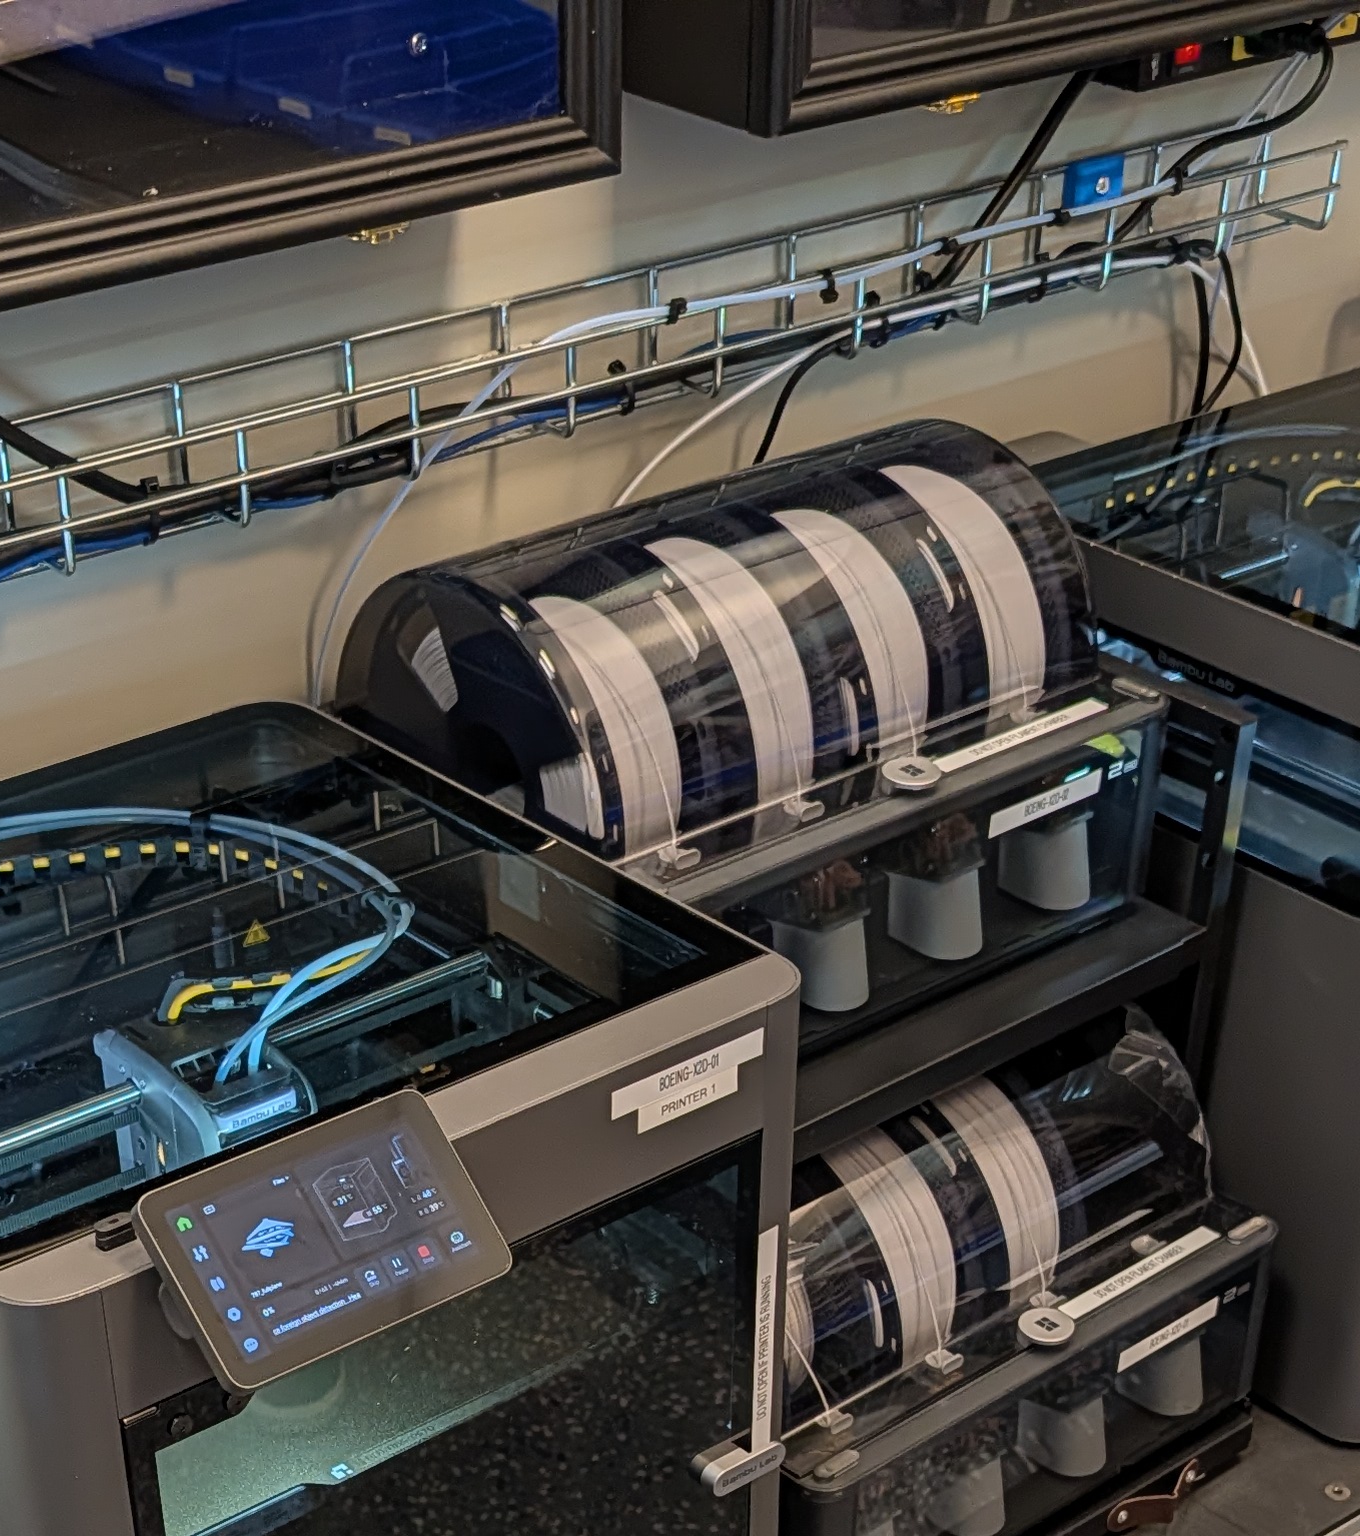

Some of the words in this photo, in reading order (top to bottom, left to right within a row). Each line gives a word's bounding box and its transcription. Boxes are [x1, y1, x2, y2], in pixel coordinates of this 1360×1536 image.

[659, 1053, 719, 1092] BOEING-X2D-01
[232, 1108, 270, 1129] Bambu
[272, 1100, 292, 1114] Lab
[661, 1088, 708, 1116] PRINTER
[711, 1083, 716, 1094] 1
[722, 1466, 757, 1488] Bambu
[759, 1453, 777, 1470] Lab
